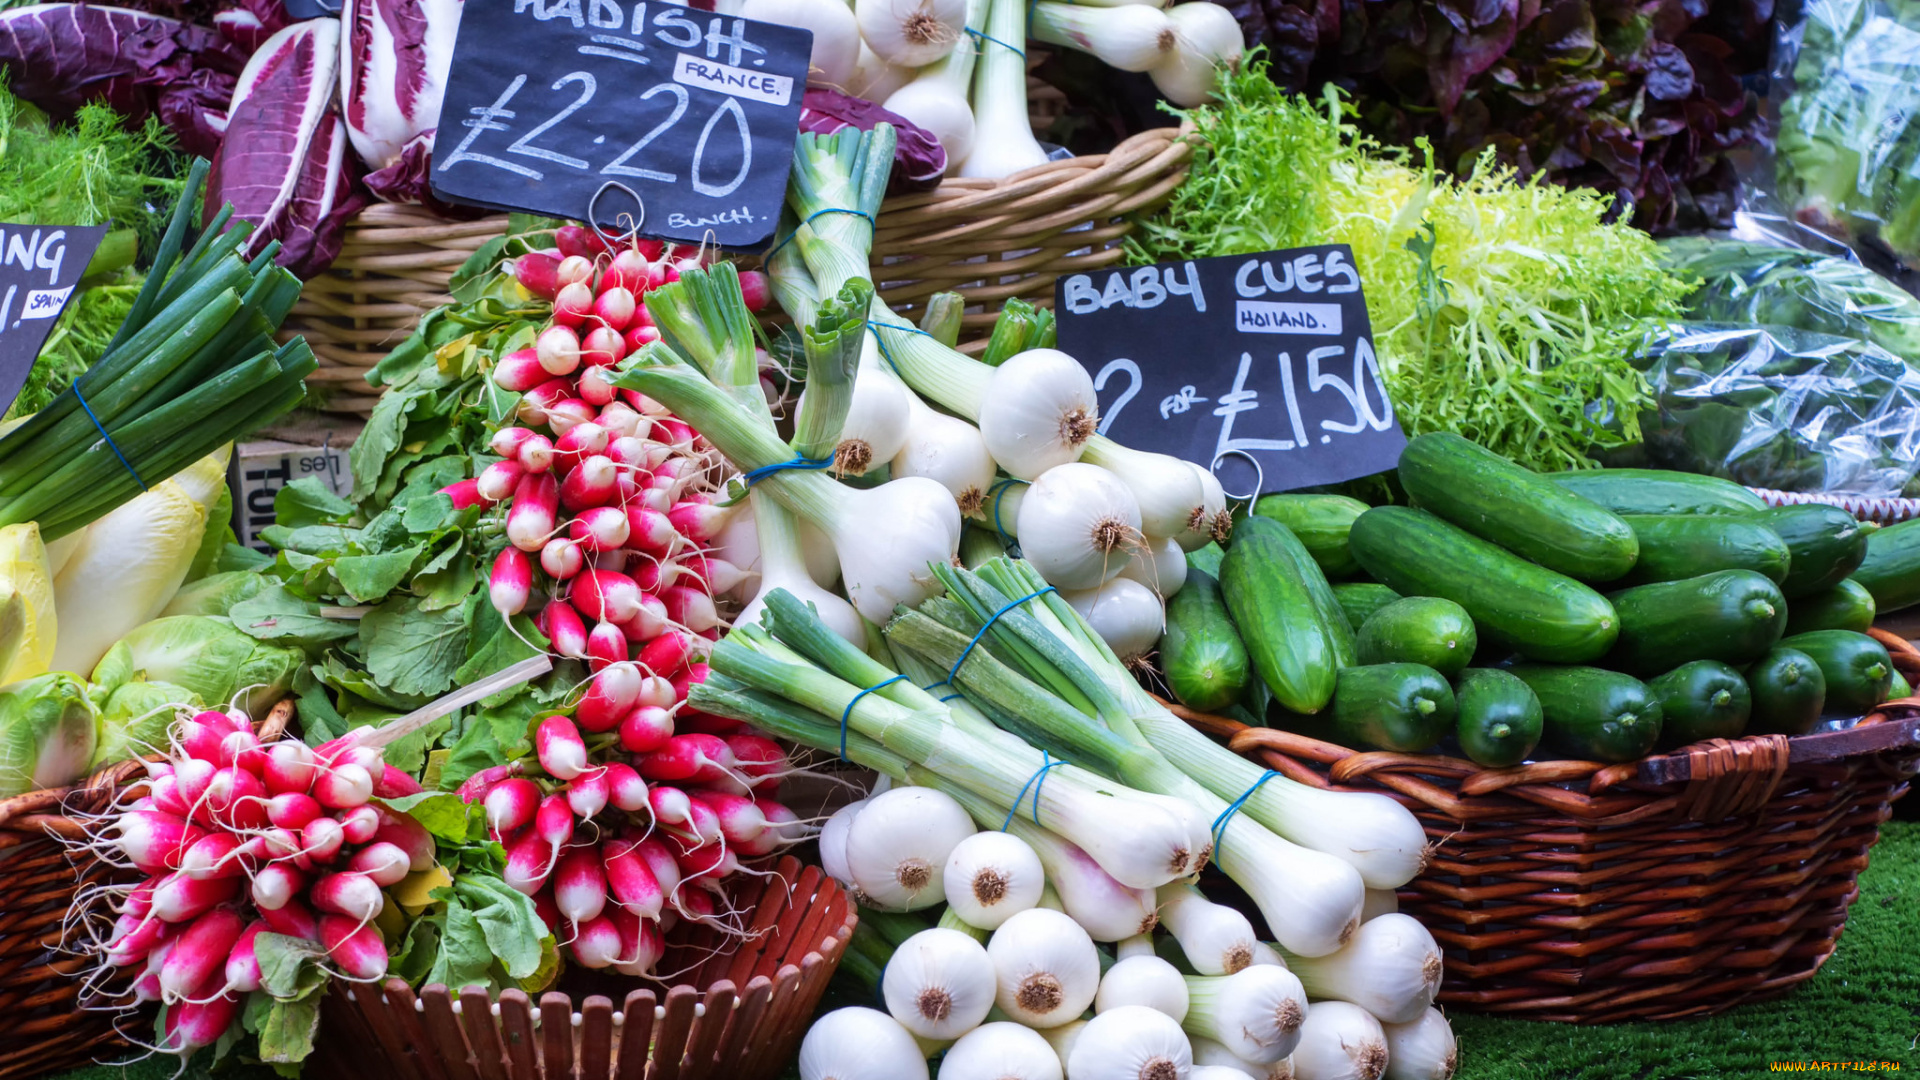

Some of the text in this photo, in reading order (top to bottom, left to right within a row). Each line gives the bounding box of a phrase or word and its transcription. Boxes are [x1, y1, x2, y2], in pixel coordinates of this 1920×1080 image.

[685, 61, 781, 97] FRANCE.
[438, 71, 752, 198] £2.20
[668, 206, 768, 229] BUNCH.
[30, 291, 67, 310] SPAIN
[1064, 251, 1361, 314] BABY CUES
[1212, 336, 1394, 470] £1.50
